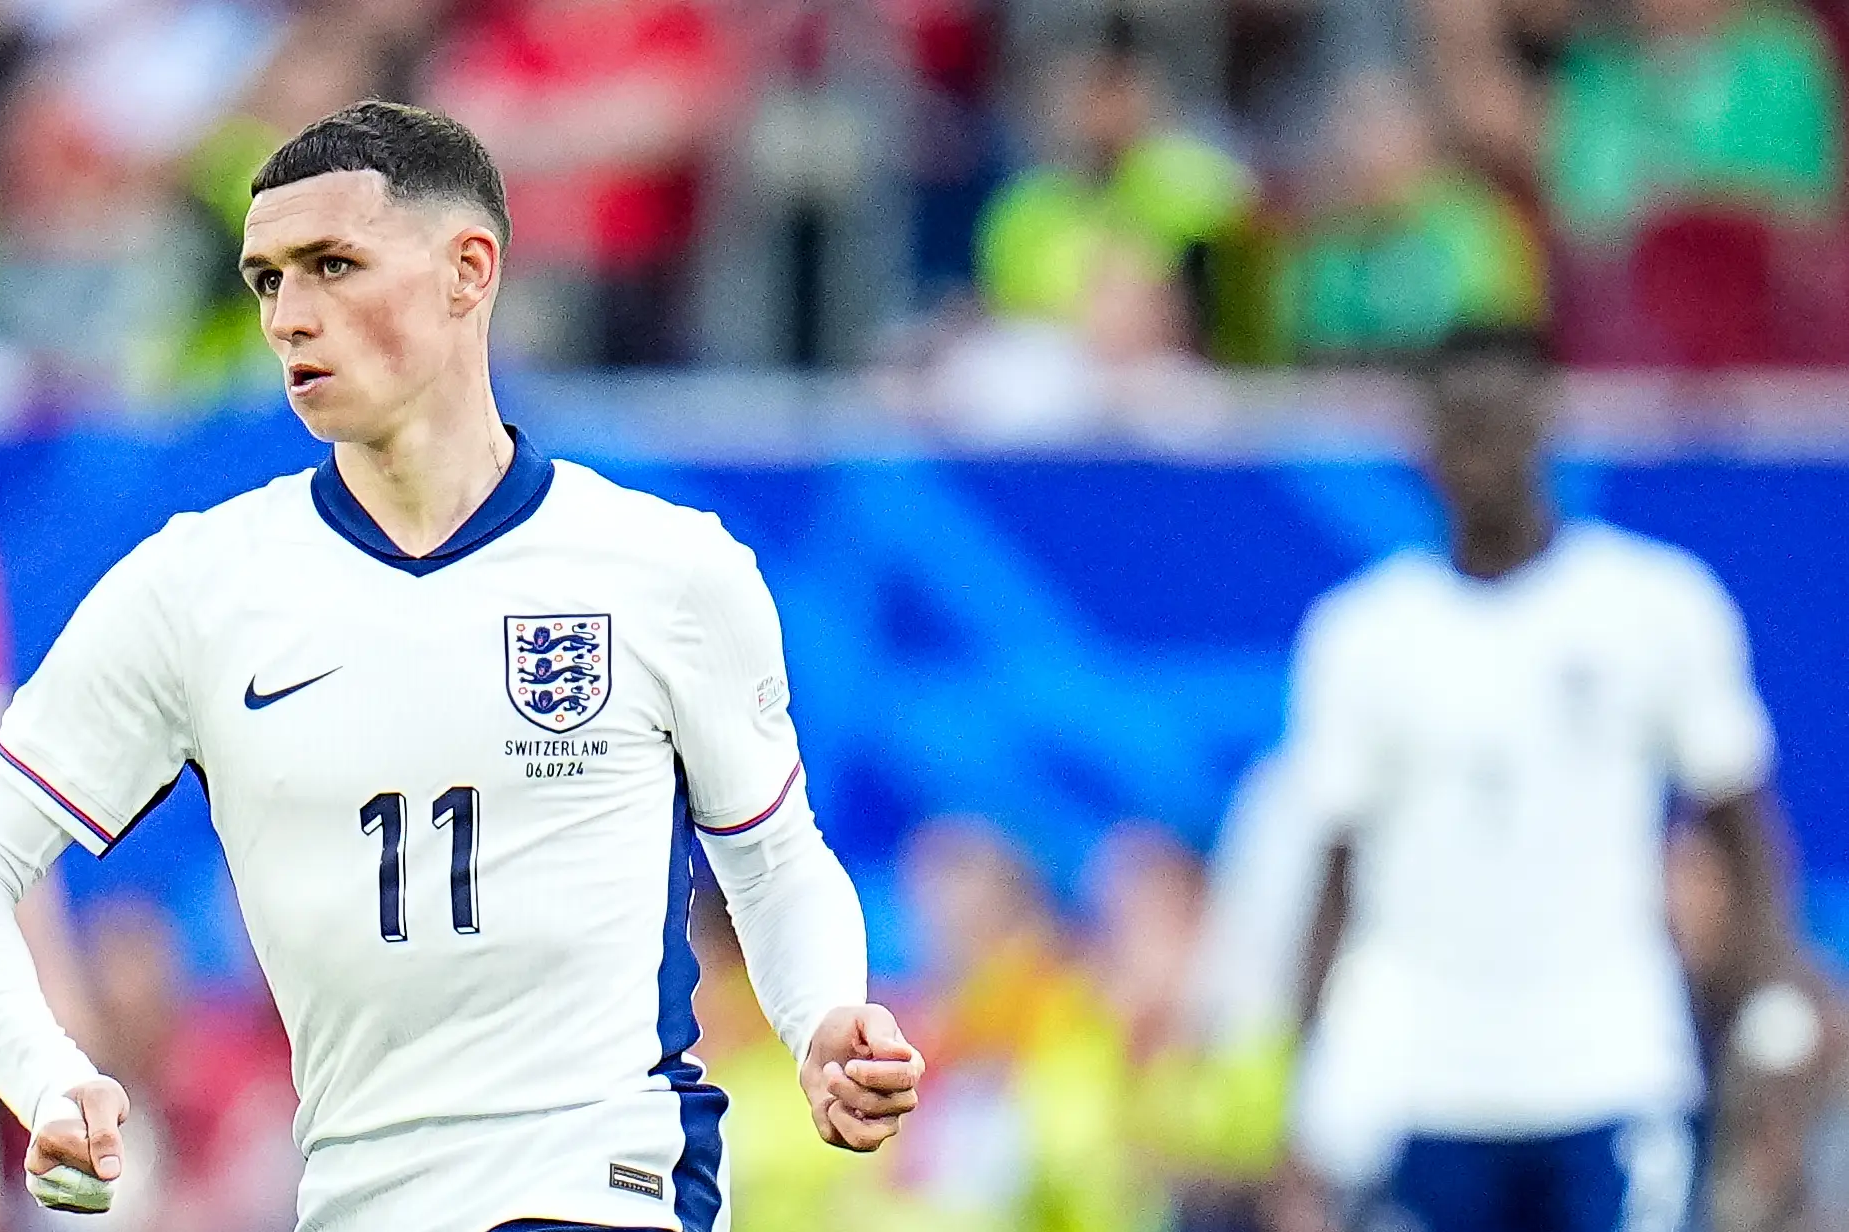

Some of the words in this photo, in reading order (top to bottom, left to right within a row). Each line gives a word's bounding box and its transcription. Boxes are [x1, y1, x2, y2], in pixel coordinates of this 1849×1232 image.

[504, 739, 608, 757] SWITZERLAND
[525, 761, 584, 778] 06.07.24
[359, 786, 480, 943] 11
